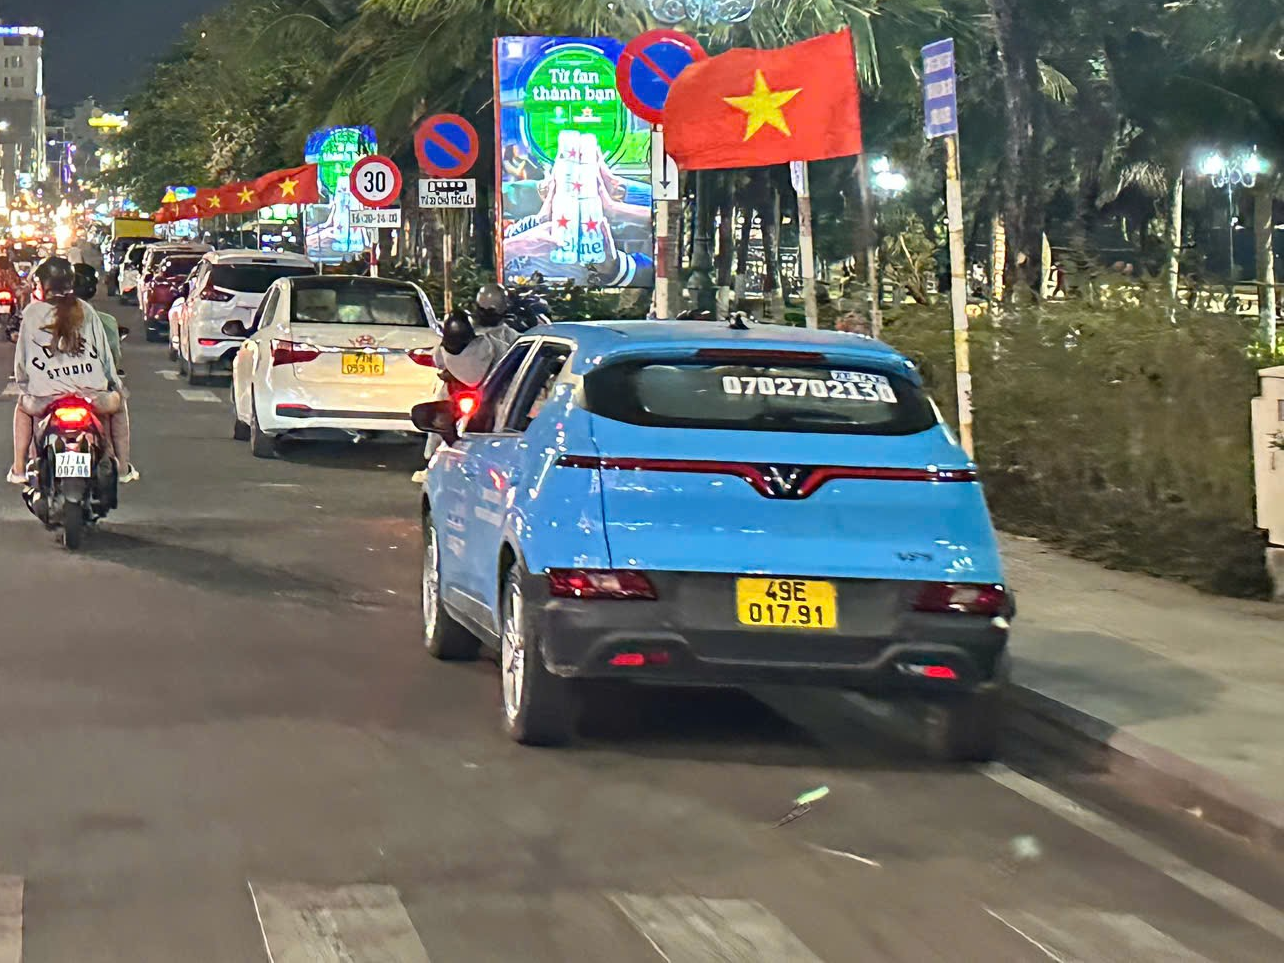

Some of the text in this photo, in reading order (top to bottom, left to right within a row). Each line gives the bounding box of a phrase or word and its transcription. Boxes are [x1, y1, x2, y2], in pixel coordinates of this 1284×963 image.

[572, 68, 600, 84] fan
[532, 84, 616, 104] thành bạn
[363, 170, 386, 193] 30
[46, 363, 93, 380] STUDIO
[722, 376, 898, 404] 0702702130
[765, 581, 807, 602] 49E
[749, 602, 823, 626] 017.91
